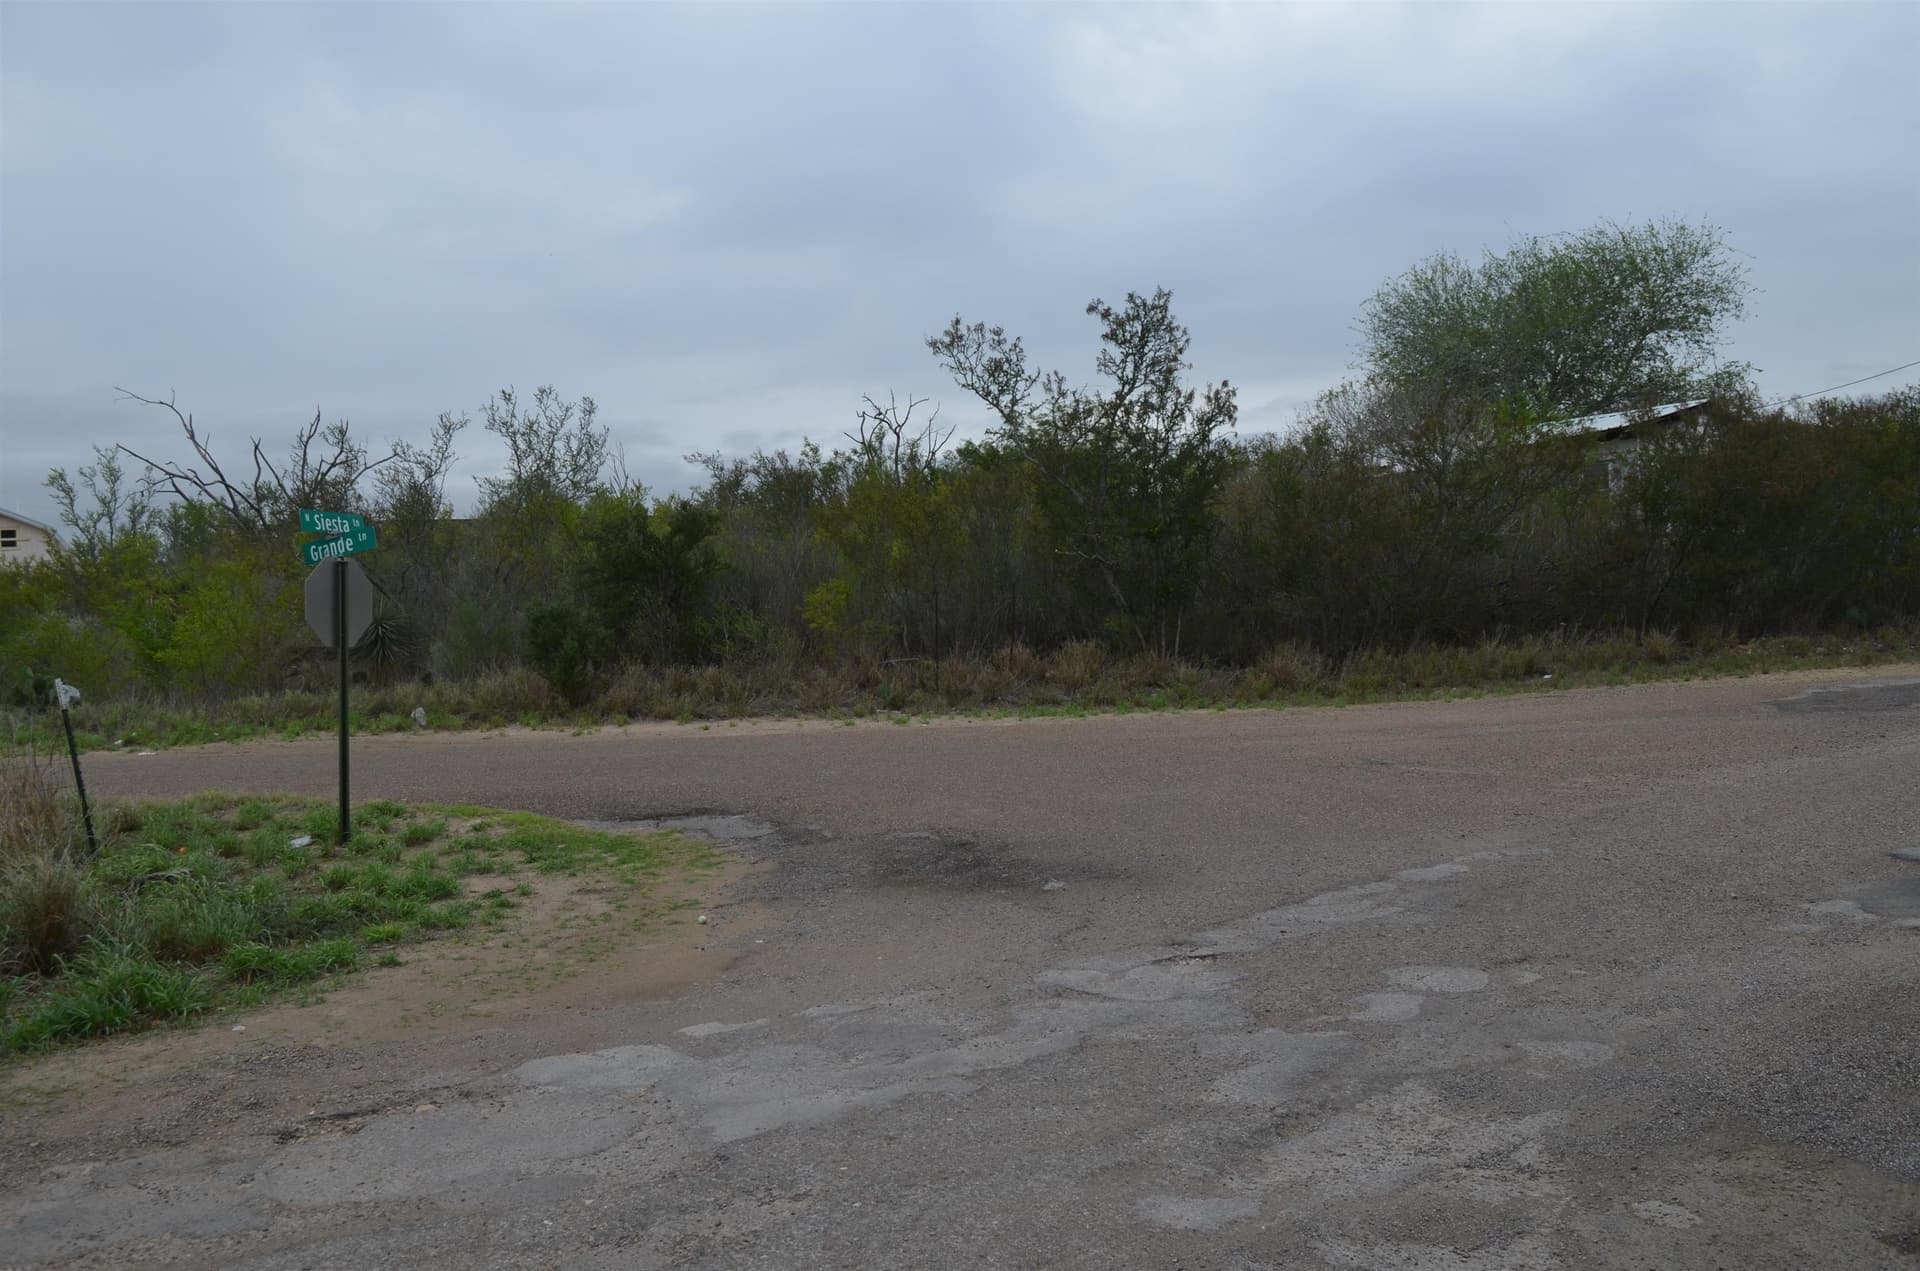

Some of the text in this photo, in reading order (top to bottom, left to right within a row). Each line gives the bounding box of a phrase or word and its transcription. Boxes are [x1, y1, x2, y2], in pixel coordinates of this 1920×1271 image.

[314, 513, 350, 533] Siesta
[352, 518, 361, 528] Ln
[310, 532, 368, 562] Grande Ln
